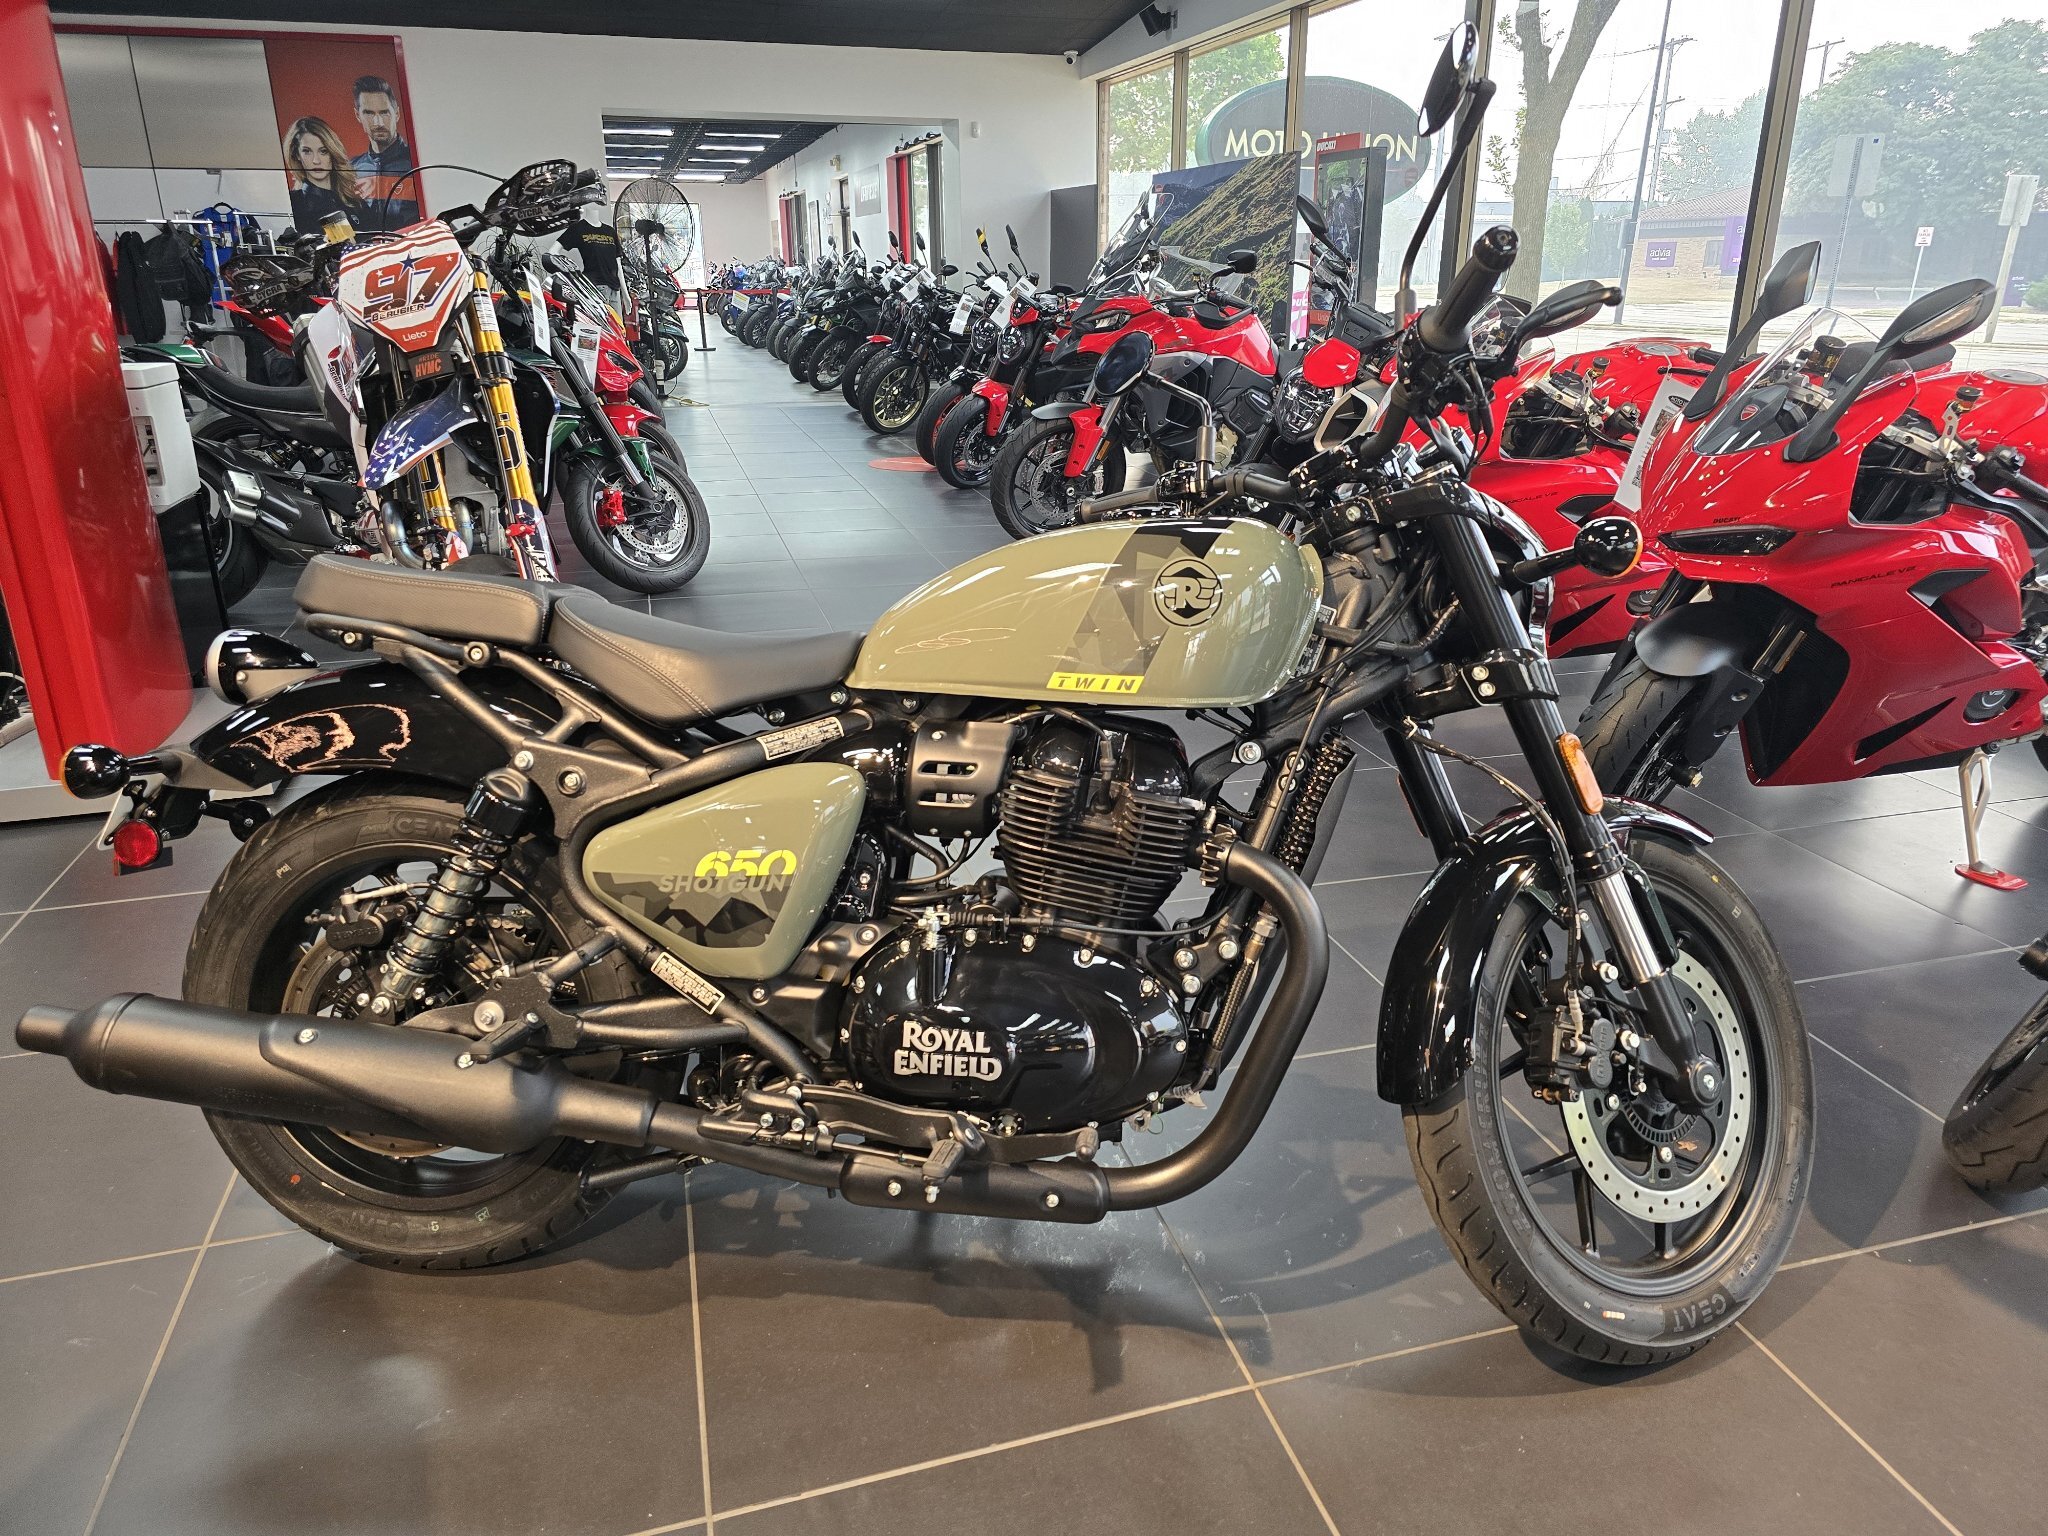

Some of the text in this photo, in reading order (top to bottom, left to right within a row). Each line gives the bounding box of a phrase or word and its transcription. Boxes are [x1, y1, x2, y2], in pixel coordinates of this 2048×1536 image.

[1316, 140, 1337, 152] DUCATI
[517, 208, 543, 219] CYCRA
[1649, 247, 1671, 257] advia
[256, 284, 283, 300] CYCRA
[364, 252, 460, 314] 97
[415, 359, 442, 377] HVMC
[1713, 516, 1741, 524] DUCATI
[1831, 565, 1917, 588] PANIGALE V2
[1058, 676, 1136, 691] TWIN
[694, 849, 797, 877] 650
[658, 874, 788, 893] SHOTGUN
[902, 1020, 991, 1053] ROYAL
[893, 1049, 1003, 1081] ENFIELD
[1673, 1293, 1728, 1333] CEAT
